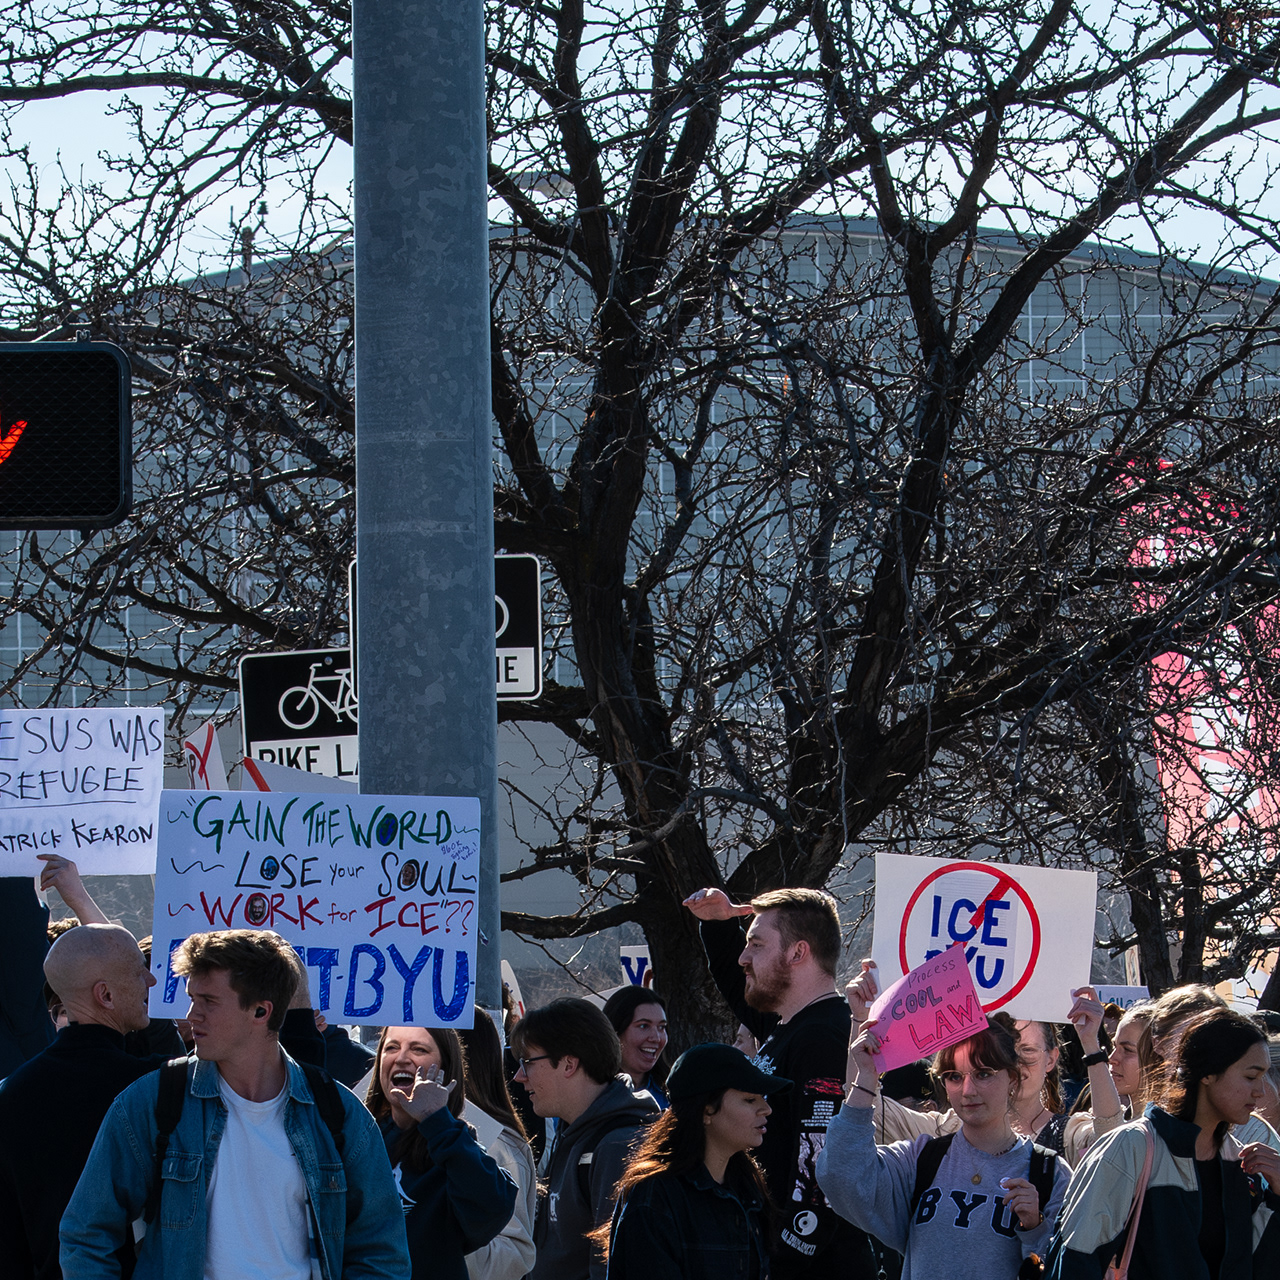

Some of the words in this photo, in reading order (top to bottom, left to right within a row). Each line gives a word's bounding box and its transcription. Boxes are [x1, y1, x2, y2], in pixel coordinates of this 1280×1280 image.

[109, 715, 162, 762] WAS
[71, 818, 153, 848] KEARON
[303, 801, 344, 847] THE
[346, 804, 452, 850] WORLD
[235, 850, 322, 889] LOSE
[329, 862, 364, 886] your
[377, 852, 476, 897] SOUL
[200, 891, 324, 930] WORK
[328, 903, 357, 924] for
[931, 895, 1011, 947] ICE
[907, 960, 956, 988] Process
[891, 986, 942, 1020] COOL
[947, 980, 961, 993] and
[908, 990, 983, 1050] LAW!
[916, 1187, 1021, 1239] BYU
